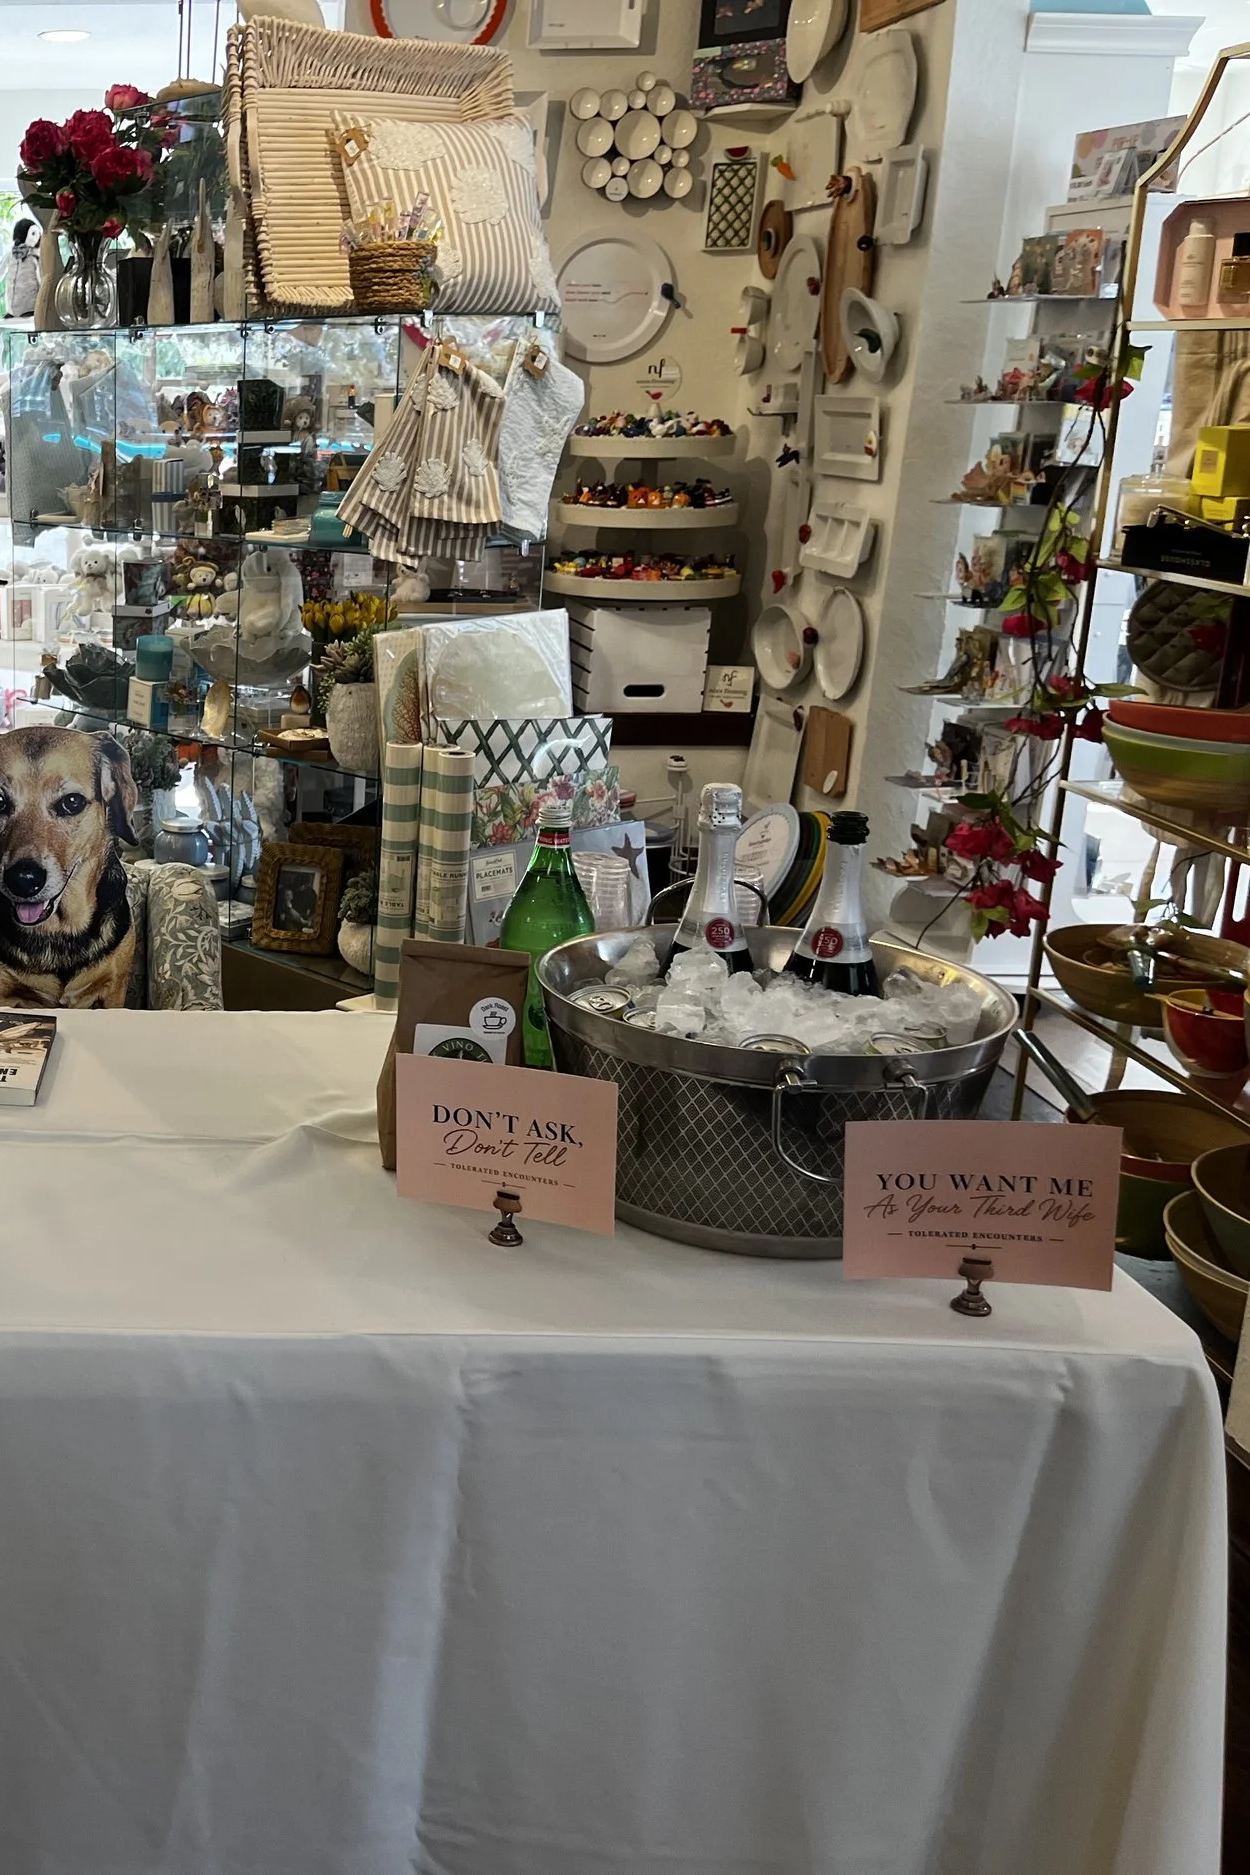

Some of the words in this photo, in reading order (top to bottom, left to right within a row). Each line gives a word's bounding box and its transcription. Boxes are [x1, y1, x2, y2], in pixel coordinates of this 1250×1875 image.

[475, 866, 513, 879] PLACEMATS
[711, 926, 730, 935] 250
[481, 1003, 492, 1012] Dark
[493, 1002, 509, 1012] Roast
[441, 1040, 474, 1052] VINO
[432, 1104, 520, 1134] DON'T
[526, 1119, 584, 1149] ASK,
[443, 1128, 519, 1158] Don't
[523, 1142, 568, 1167] Tell
[451, 1162, 500, 1176] TOLERATED
[502, 1171, 559, 1187] ENCOUNTERS
[877, 1173, 938, 1191] YOU
[949, 1173, 1038, 1193] WANT
[1049, 1177, 1094, 1198] ME
[863, 1193, 899, 1219] As
[905, 1193, 963, 1223] Your
[969, 1194, 1032, 1219] Third
[1037, 1197, 1097, 1228] Wife
[908, 1230, 969, 1239] TOLERATED
[972, 1231, 1043, 1242] ENCOUNTERS
